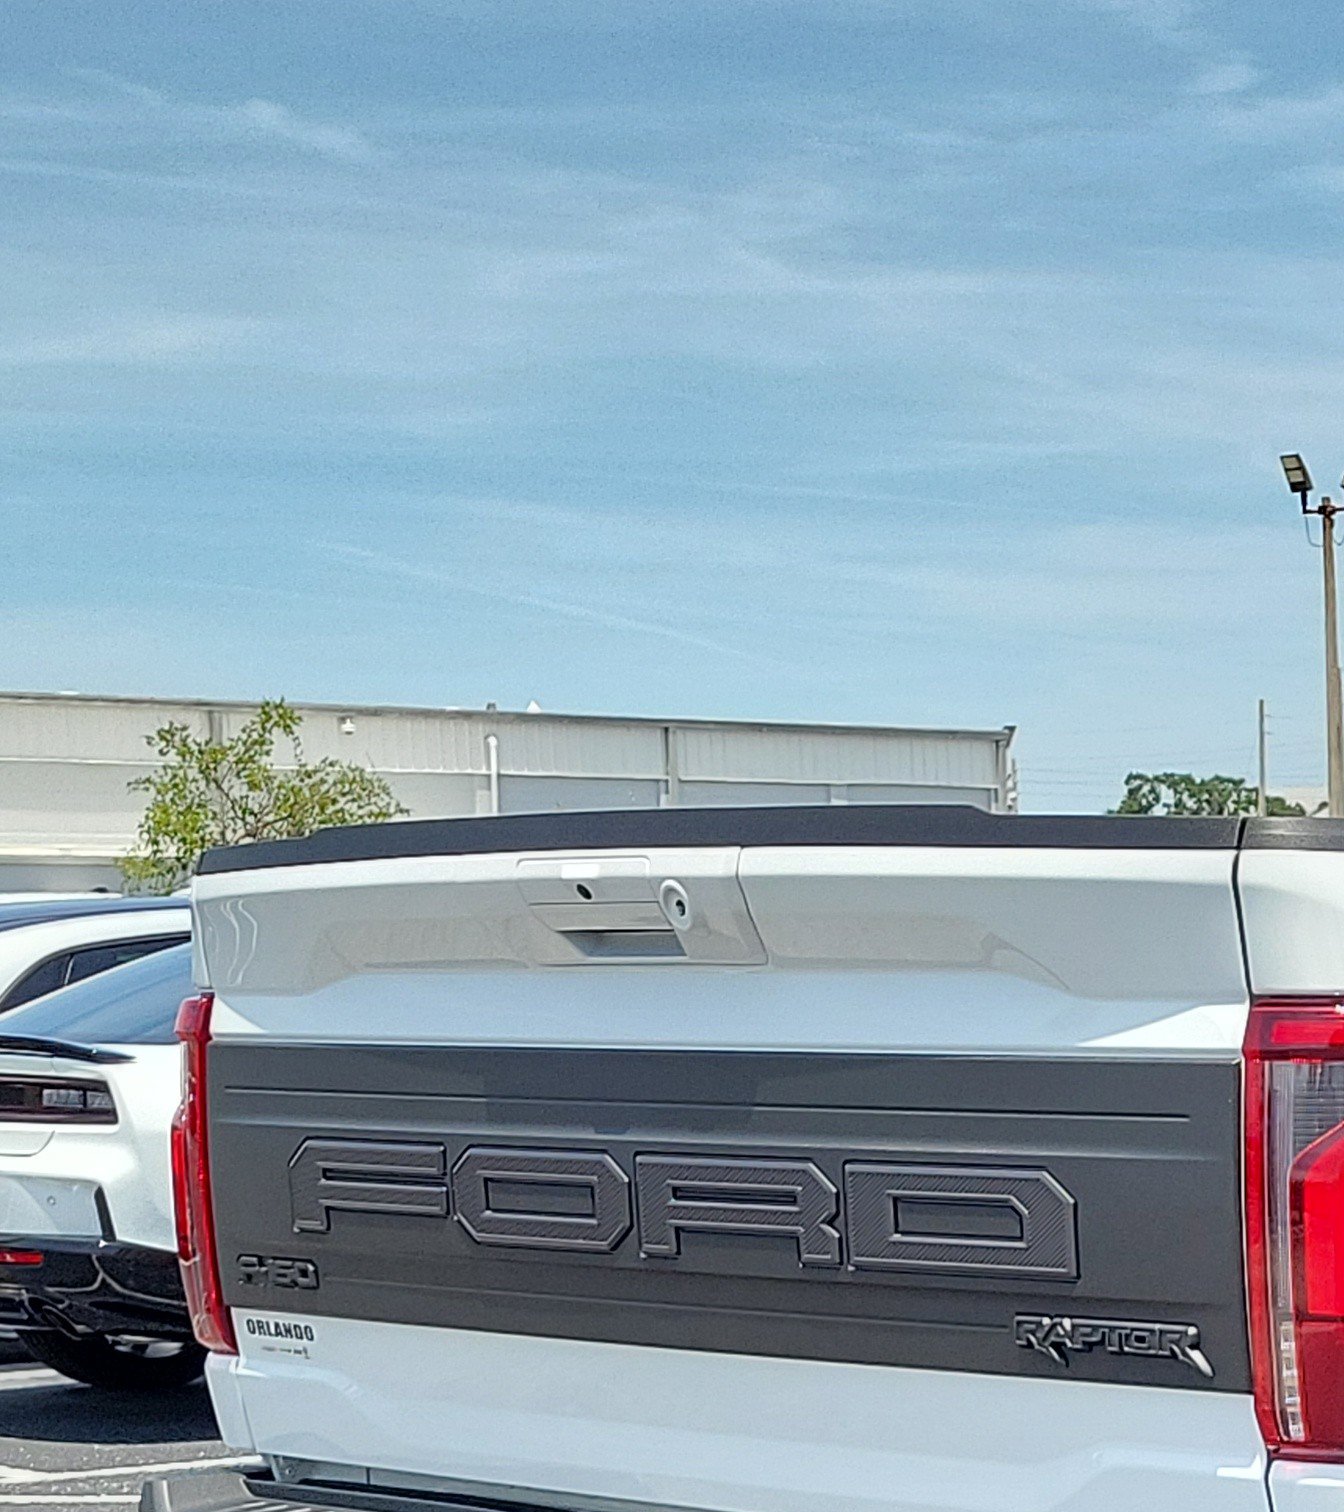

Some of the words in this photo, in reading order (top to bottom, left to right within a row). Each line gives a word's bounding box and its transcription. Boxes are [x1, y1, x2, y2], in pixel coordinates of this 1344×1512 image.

[288, 1137, 1081, 1281] FORD
[246, 1318, 315, 1342] ORLANDO
[1014, 1311, 1215, 1378] RAPTOR
